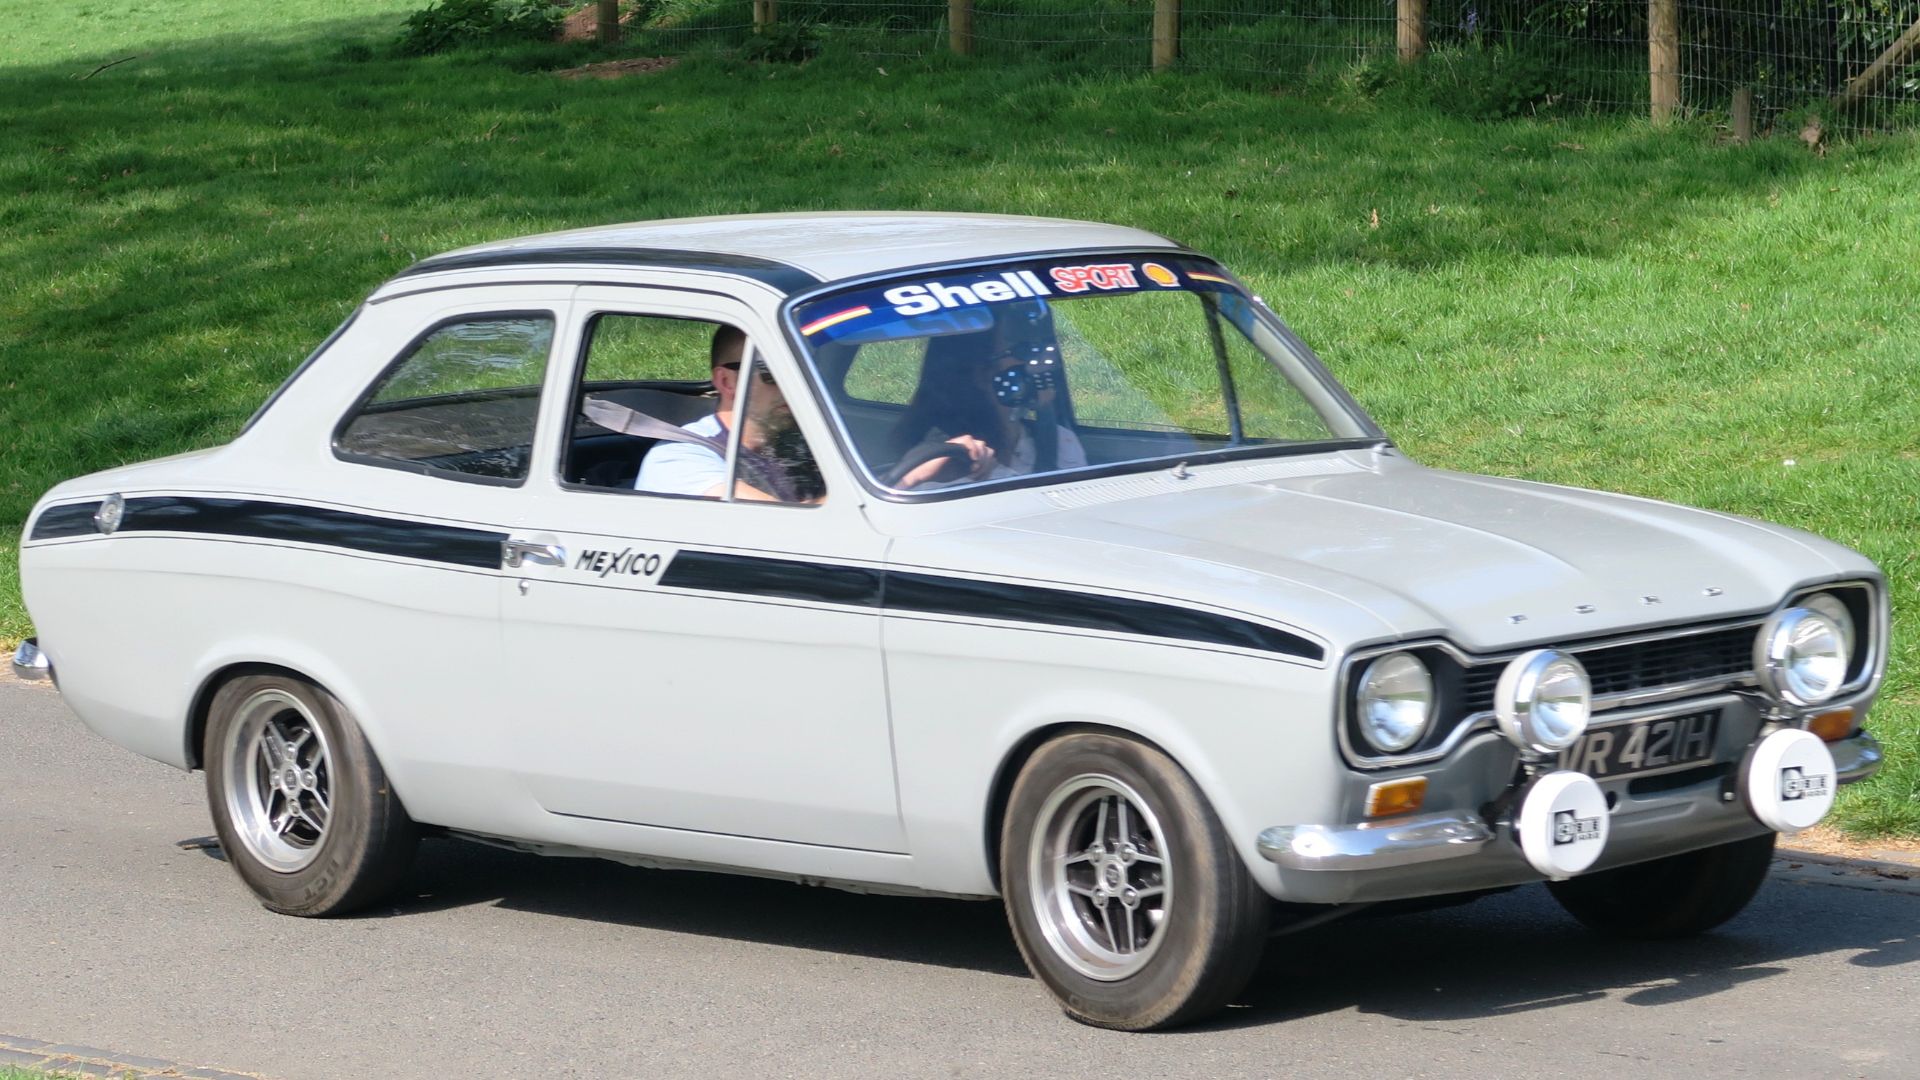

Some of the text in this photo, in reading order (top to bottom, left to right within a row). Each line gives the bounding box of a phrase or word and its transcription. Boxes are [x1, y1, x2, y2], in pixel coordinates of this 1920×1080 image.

[884, 263, 1140, 316] Shell SPORT
[574, 547, 662, 578] MEXICO
[1618, 713, 1714, 769] 421H
